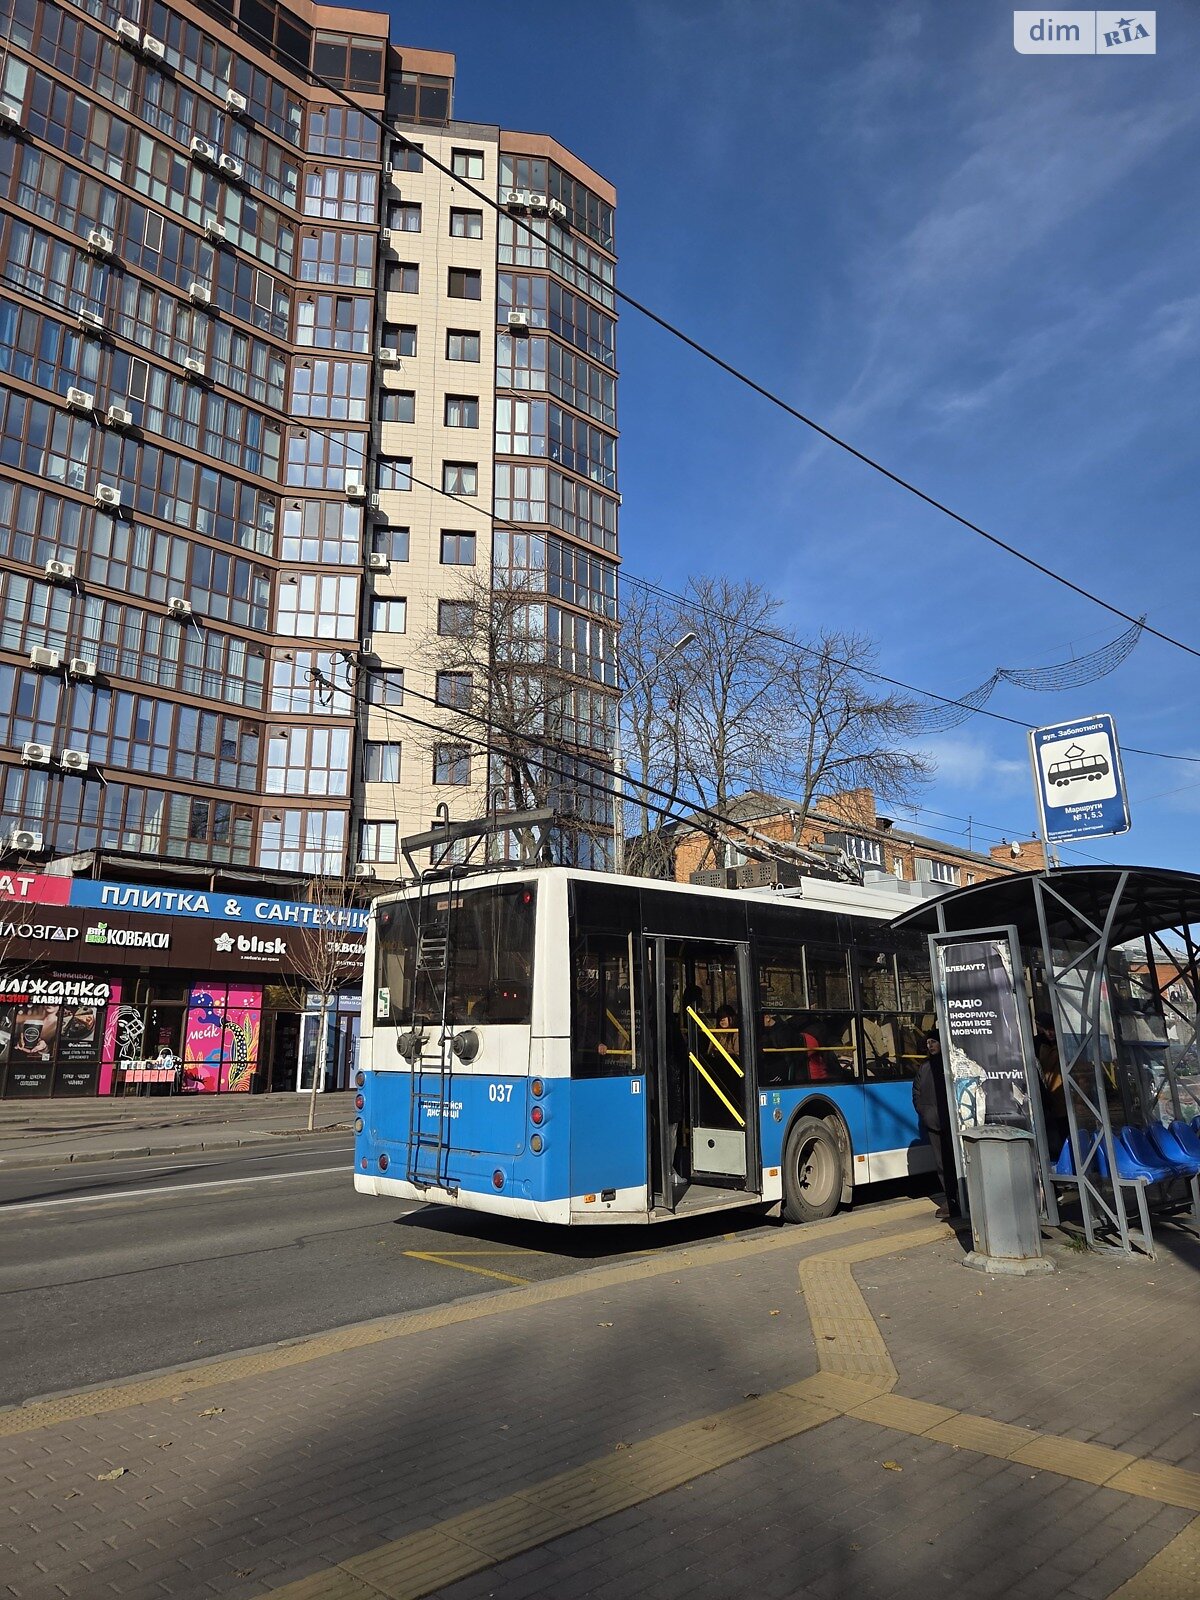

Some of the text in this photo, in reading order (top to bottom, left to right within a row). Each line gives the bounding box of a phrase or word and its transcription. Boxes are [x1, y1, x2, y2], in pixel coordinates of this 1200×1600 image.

[1042, 723, 1104, 741] вул. Заболотного
[1065, 803, 1103, 814] Маршрути
[1073, 813, 1082, 821] №
[101, 885, 209, 913] ПЛИТКА
[224, 899, 242, 916] &
[107, 929, 170, 949] КОВБАСИ
[238, 935, 287, 954] blisk
[945, 963, 985, 973] БЛЕКАУТ?
[32, 995, 63, 1004] КАВИ
[66, 996, 79, 1006] ТА
[80, 997, 106, 1007] ЧАЮ
[948, 999, 983, 1009] РАДІО
[950, 1011, 998, 1019] ІНФОРМУЄ,
[951, 1019, 992, 1028] КОЛИ ВСЕ
[952, 1028, 993, 1036] МОВЧИТЬ
[986, 1069, 1024, 1080] ШТУЙ!
[488, 1084, 513, 1102] 037
[426, 1109, 459, 1119] ДИСАНЦІЇ
